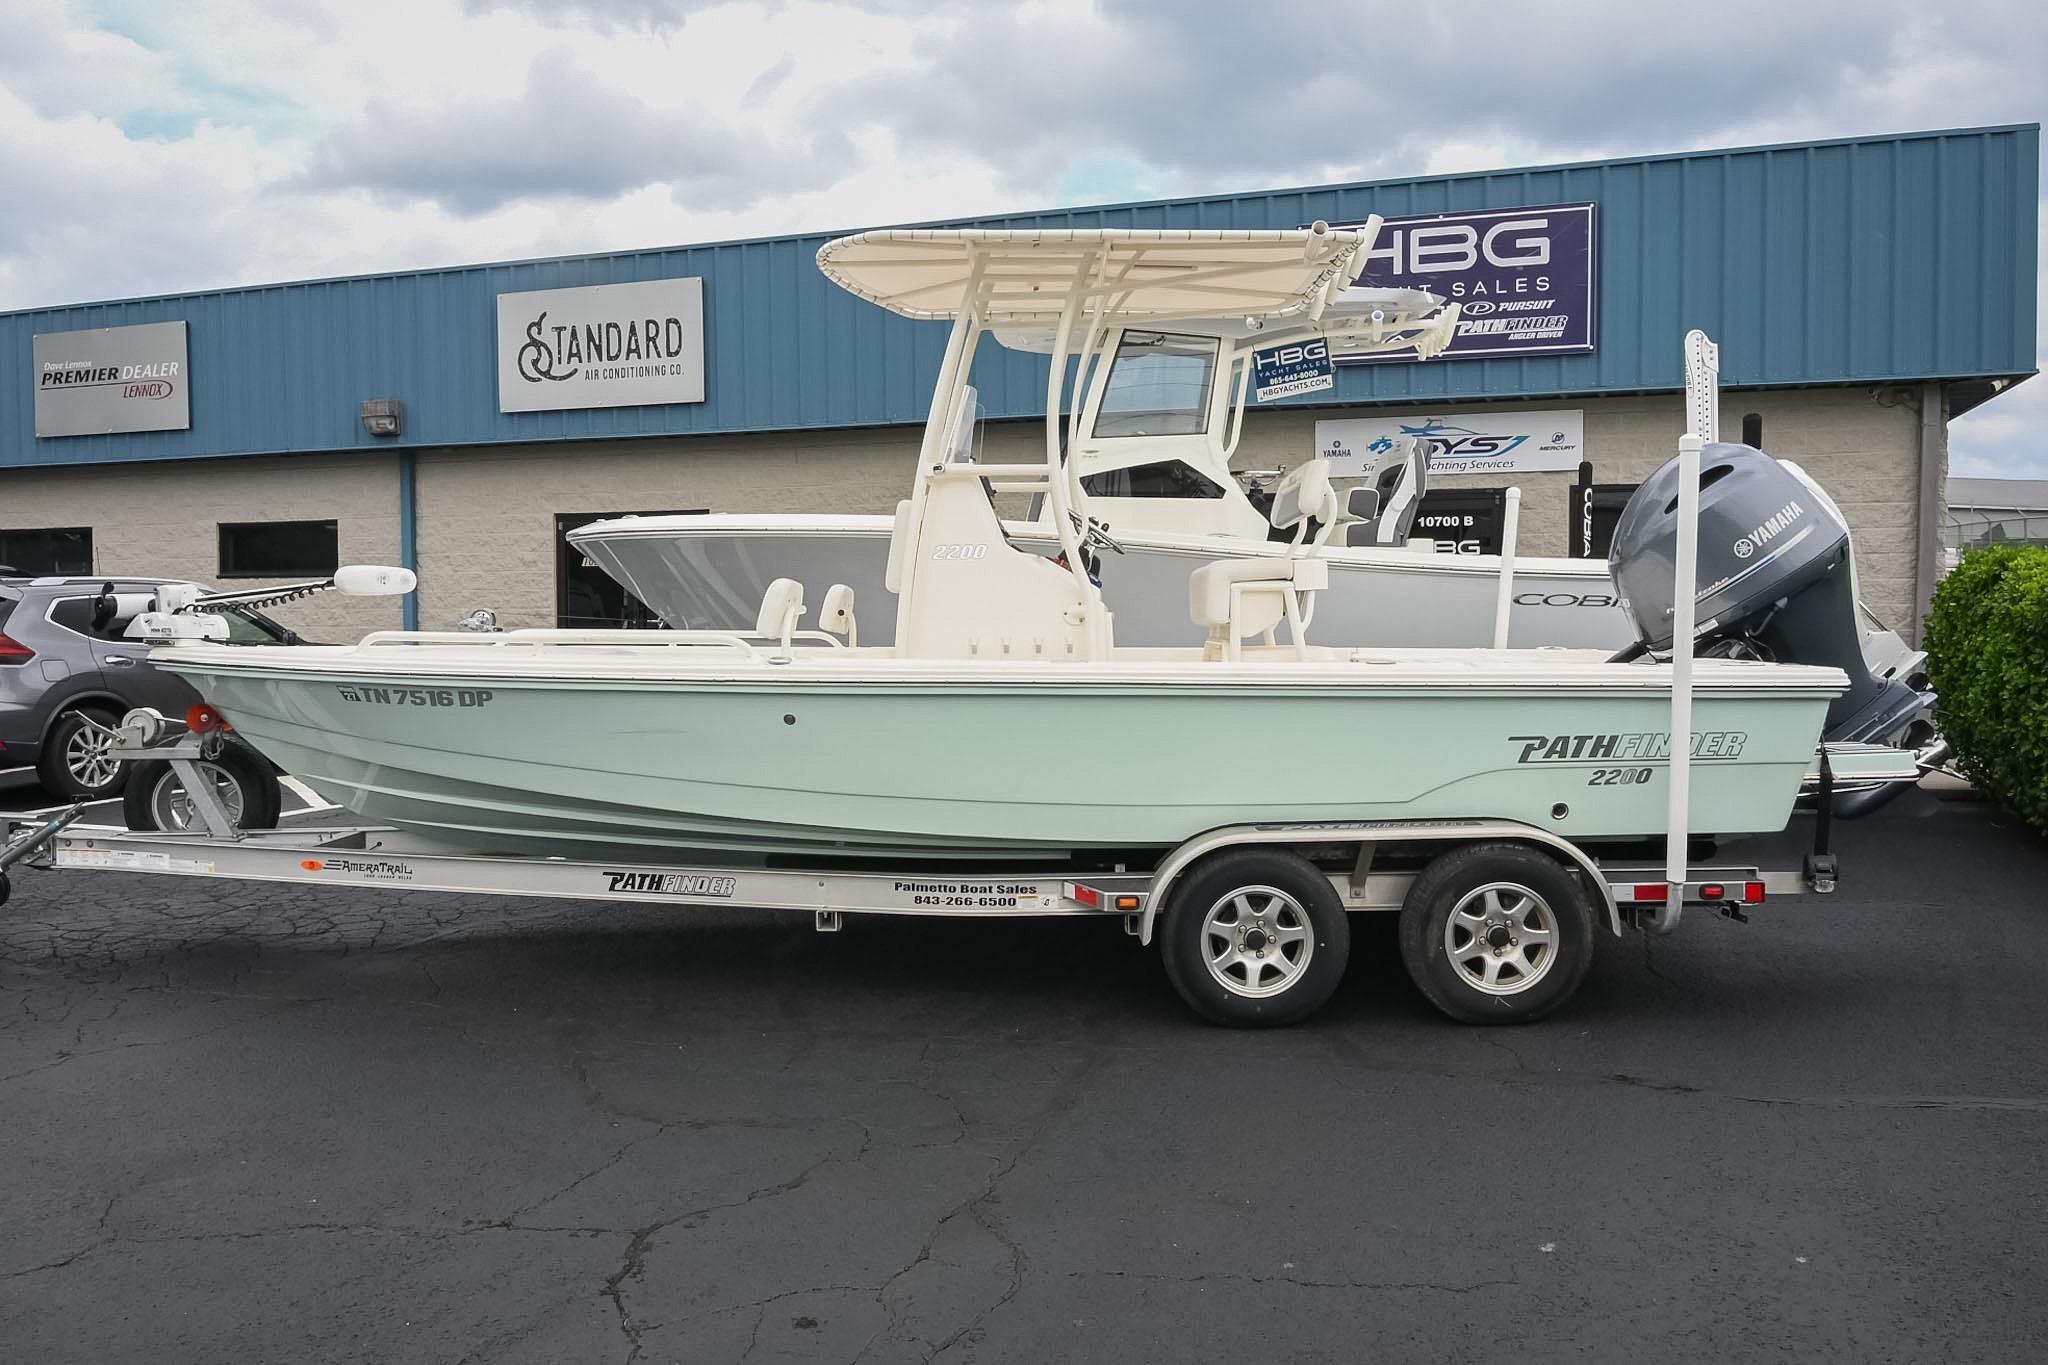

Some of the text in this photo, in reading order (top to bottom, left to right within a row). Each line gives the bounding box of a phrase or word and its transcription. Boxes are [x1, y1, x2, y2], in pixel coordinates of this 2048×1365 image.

[1368, 218, 1551, 276] HBG
[1452, 276, 1551, 297] SALES
[1498, 299, 1556, 312] PURSUIT
[1456, 315, 1569, 336] PATHFINDER
[1508, 330, 1564, 341] ANGLER DRIVEN
[517, 311, 683, 383] STANDARD
[1256, 341, 1327, 370] HBG
[41, 361, 179, 386] PREMIER DEALER
[43, 359, 93, 371] Dave Lennox
[584, 363, 685, 381] AIR CONDITIONING CO.
[1258, 359, 1328, 378] YACHT SALES
[123, 383, 164, 399] LENNOX
[1262, 377, 1329, 397] HBGYACHTS.COM
[1322, 449, 1352, 458] YAMAHA
[1469, 460, 1515, 470] Services
[1417, 515, 1474, 528] 10700 B
[1583, 487, 1593, 558] COBIA
[1747, 500, 1804, 548] YAMAHA
[1433, 540, 1481, 555] BG
[1512, 593, 1619, 607] COBI
[359, 687, 391, 704] TN
[392, 690, 455, 707] 7516
[458, 690, 494, 708] DP
[1587, 767, 1653, 786] 2200
[602, 871, 737, 897] PATHFINDER
[894, 882, 1038, 895] Palmetto Boat Sales
[913, 895, 1018, 907] 843-266-6500
